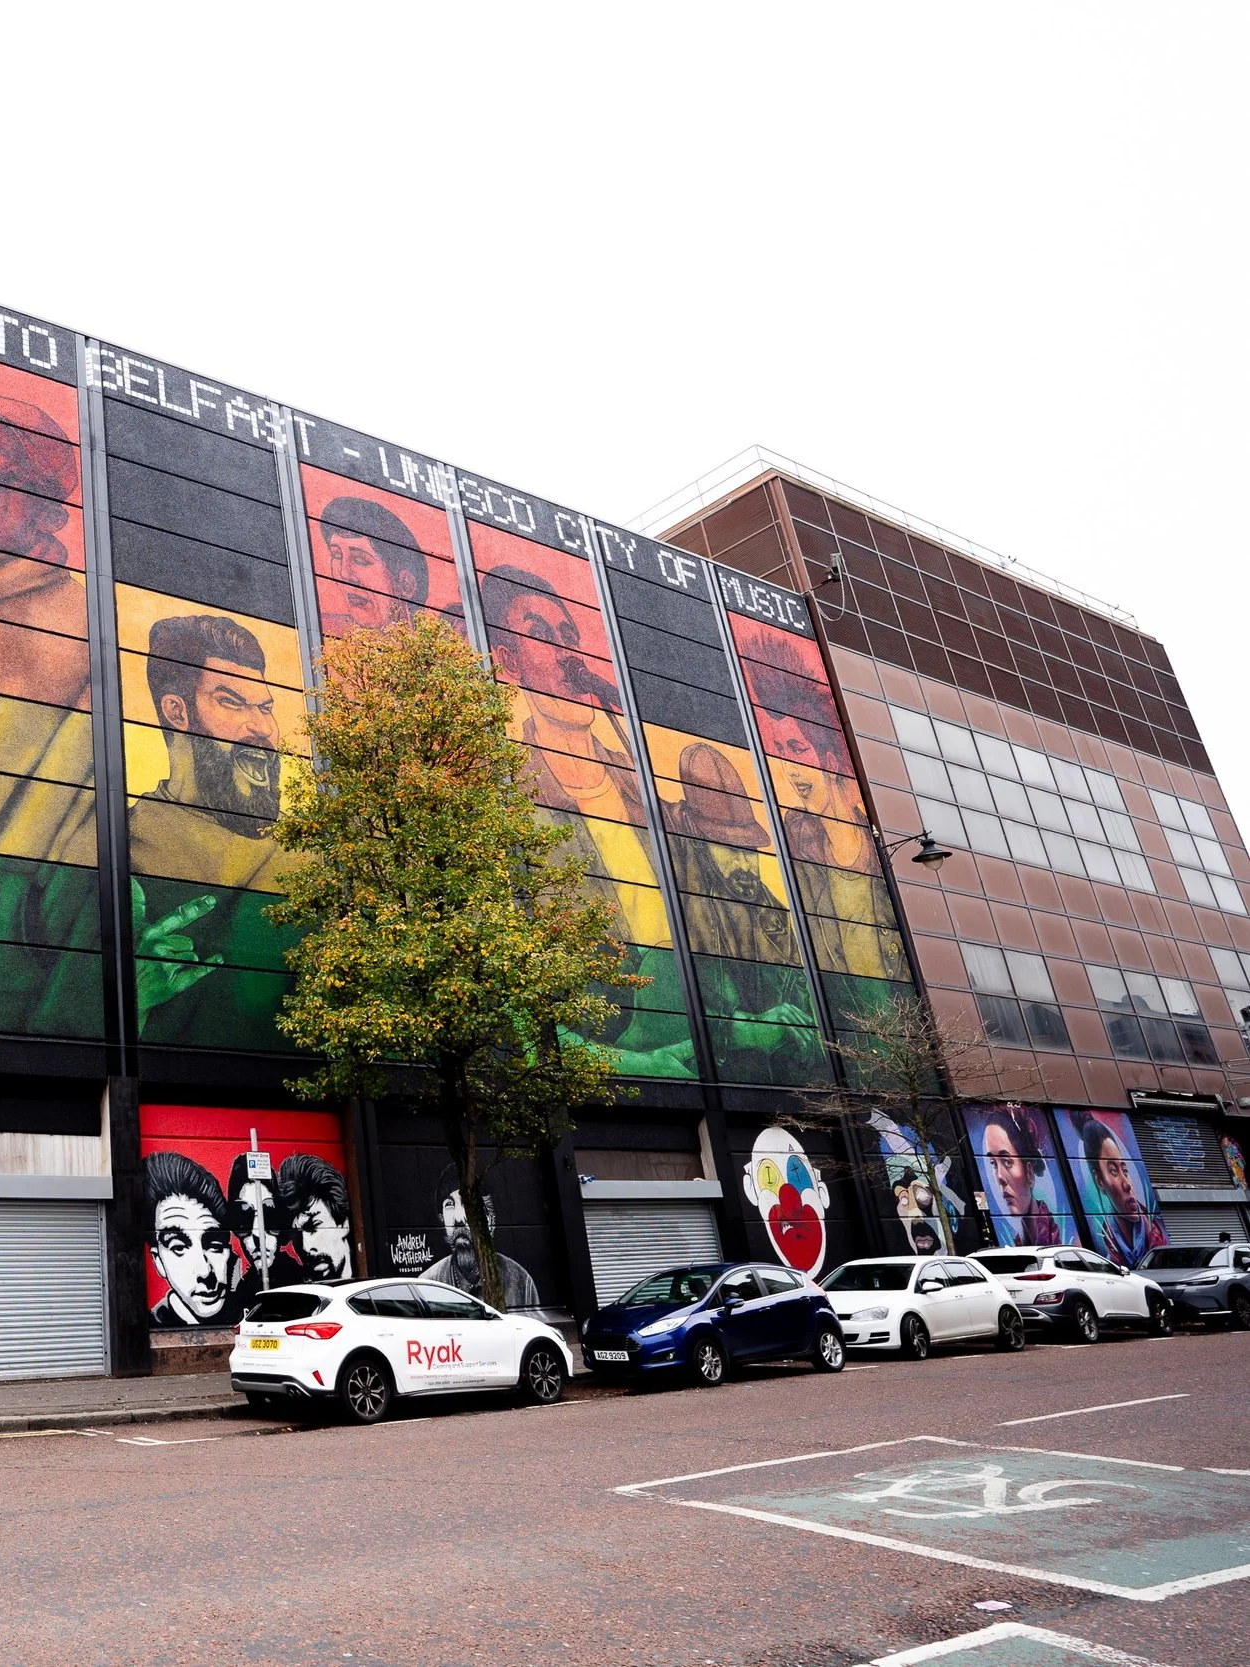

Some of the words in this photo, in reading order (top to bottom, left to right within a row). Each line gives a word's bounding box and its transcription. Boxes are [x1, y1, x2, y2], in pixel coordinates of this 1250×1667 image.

[85, 347, 316, 457] BELFAST
[379, 446, 537, 534] UNESCO
[555, 511, 637, 570] CITY
[658, 549, 698, 589] OF
[718, 571, 806, 630] MUSIC
[390, 1244, 434, 1265] WEATHERALL
[262, 1339, 278, 1349] 3070
[406, 1338, 463, 1371] Ryak
[609, 1352, 626, 1360] 9209
